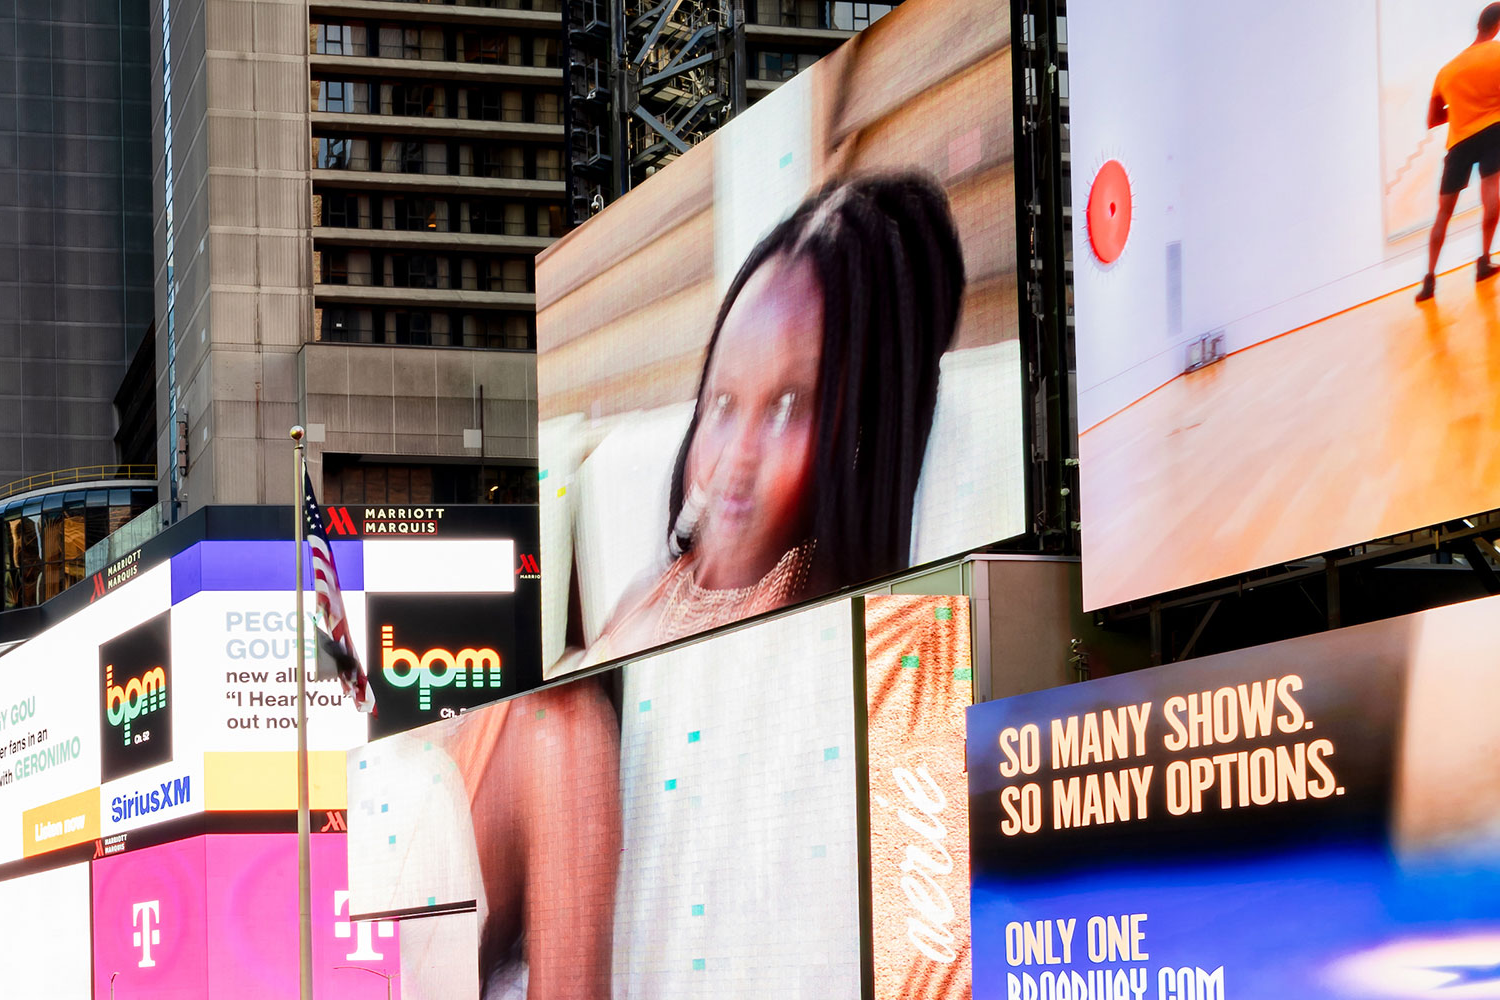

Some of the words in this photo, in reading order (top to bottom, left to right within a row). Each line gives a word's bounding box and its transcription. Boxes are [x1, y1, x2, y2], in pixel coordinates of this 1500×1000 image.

[365, 508, 445, 520] MARRIOTT
[365, 522, 437, 534] MARQUIS
[107, 549, 142, 577] MARRIOTT
[107, 564, 138, 589] MARQUIS
[226, 670, 268, 683] new
[382, 625, 502, 711] bpm
[10, 695, 36, 725] GOU
[106, 664, 167, 746] bpm
[250, 692, 297, 706] Hear
[227, 717, 262, 730] out
[999, 724, 1041, 778] SO
[1051, 702, 1153, 769] MANY
[1163, 675, 1315, 752] SHOWS.
[9, 737, 27, 755] fans
[27, 732, 36, 747] in
[37, 728, 48, 743] an
[14, 736, 81, 781] GERONIMO
[111, 776, 190, 823] SiriusXM
[1000, 782, 1042, 836] SO
[1053, 766, 1154, 830] MANY
[1165, 739, 1346, 816] OPTIONS.
[64, 814, 86, 833] now
[876, 763, 957, 964] aerie
[133, 900, 160, 968] T
[1005, 919, 1077, 966] ONLY
[1087, 914, 1149, 963] ONE
